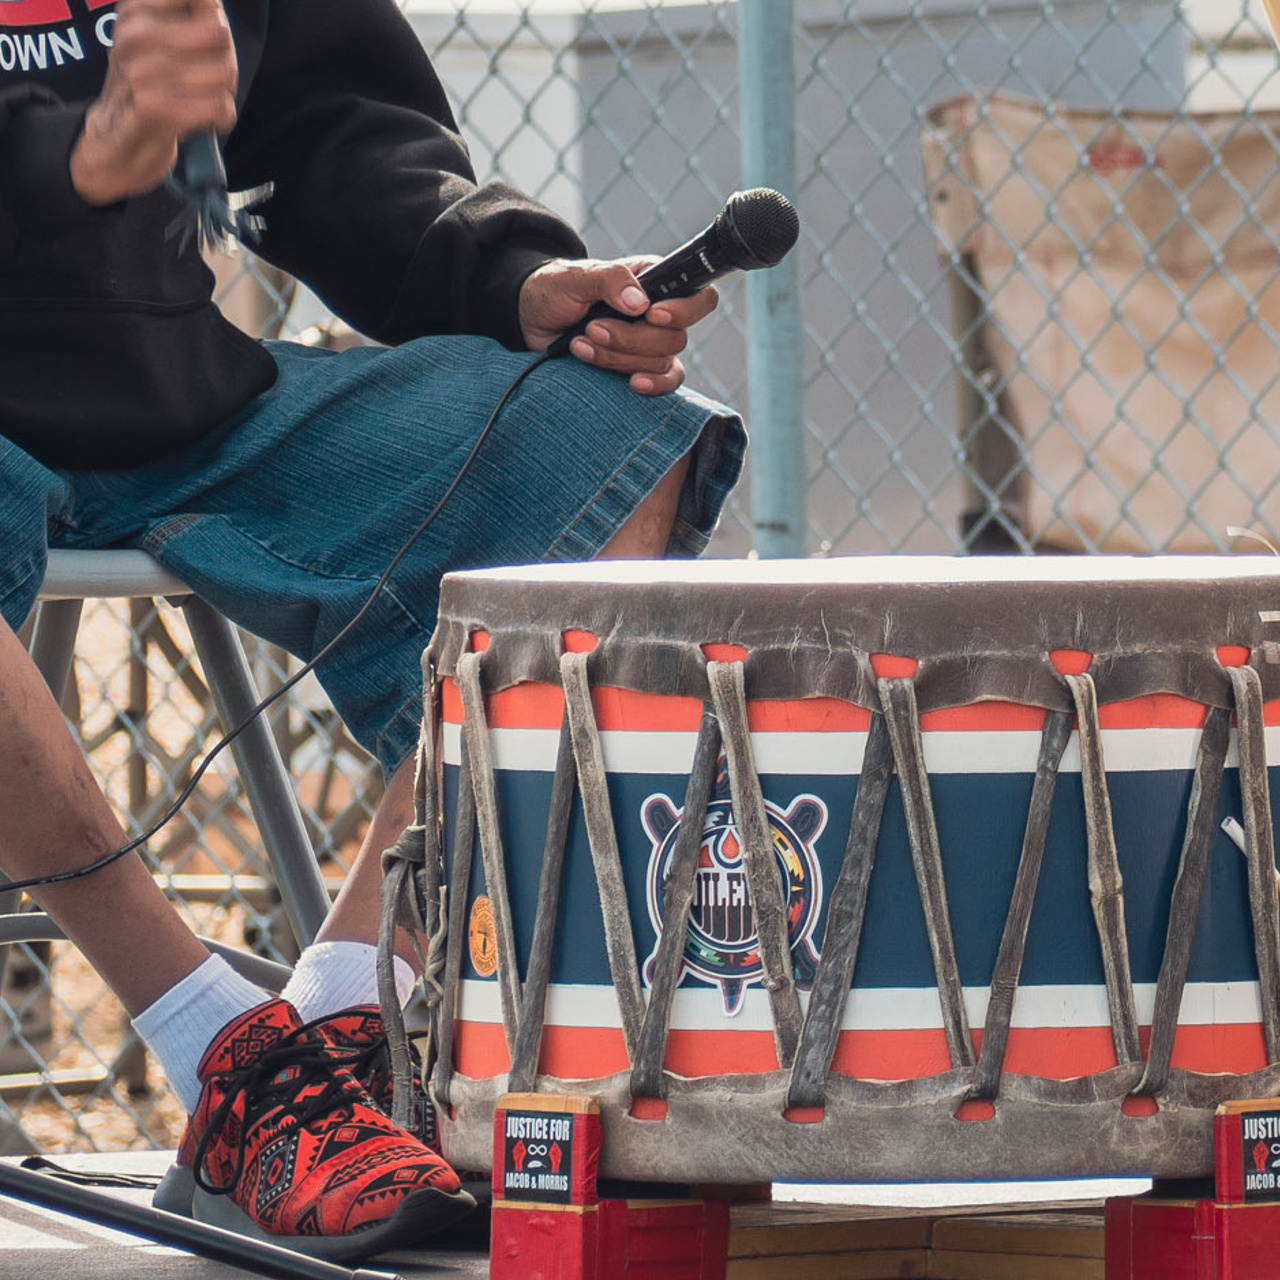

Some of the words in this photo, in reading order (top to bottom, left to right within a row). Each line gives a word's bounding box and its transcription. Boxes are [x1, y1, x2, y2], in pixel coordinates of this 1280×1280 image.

[506, 1116, 548, 1139] JUSTICE
[550, 1119, 570, 1141] FOR
[505, 1172, 530, 1188] JACOB
[538, 1174, 568, 1191] MORRIS
[1246, 1173, 1275, 1190] JACOB
